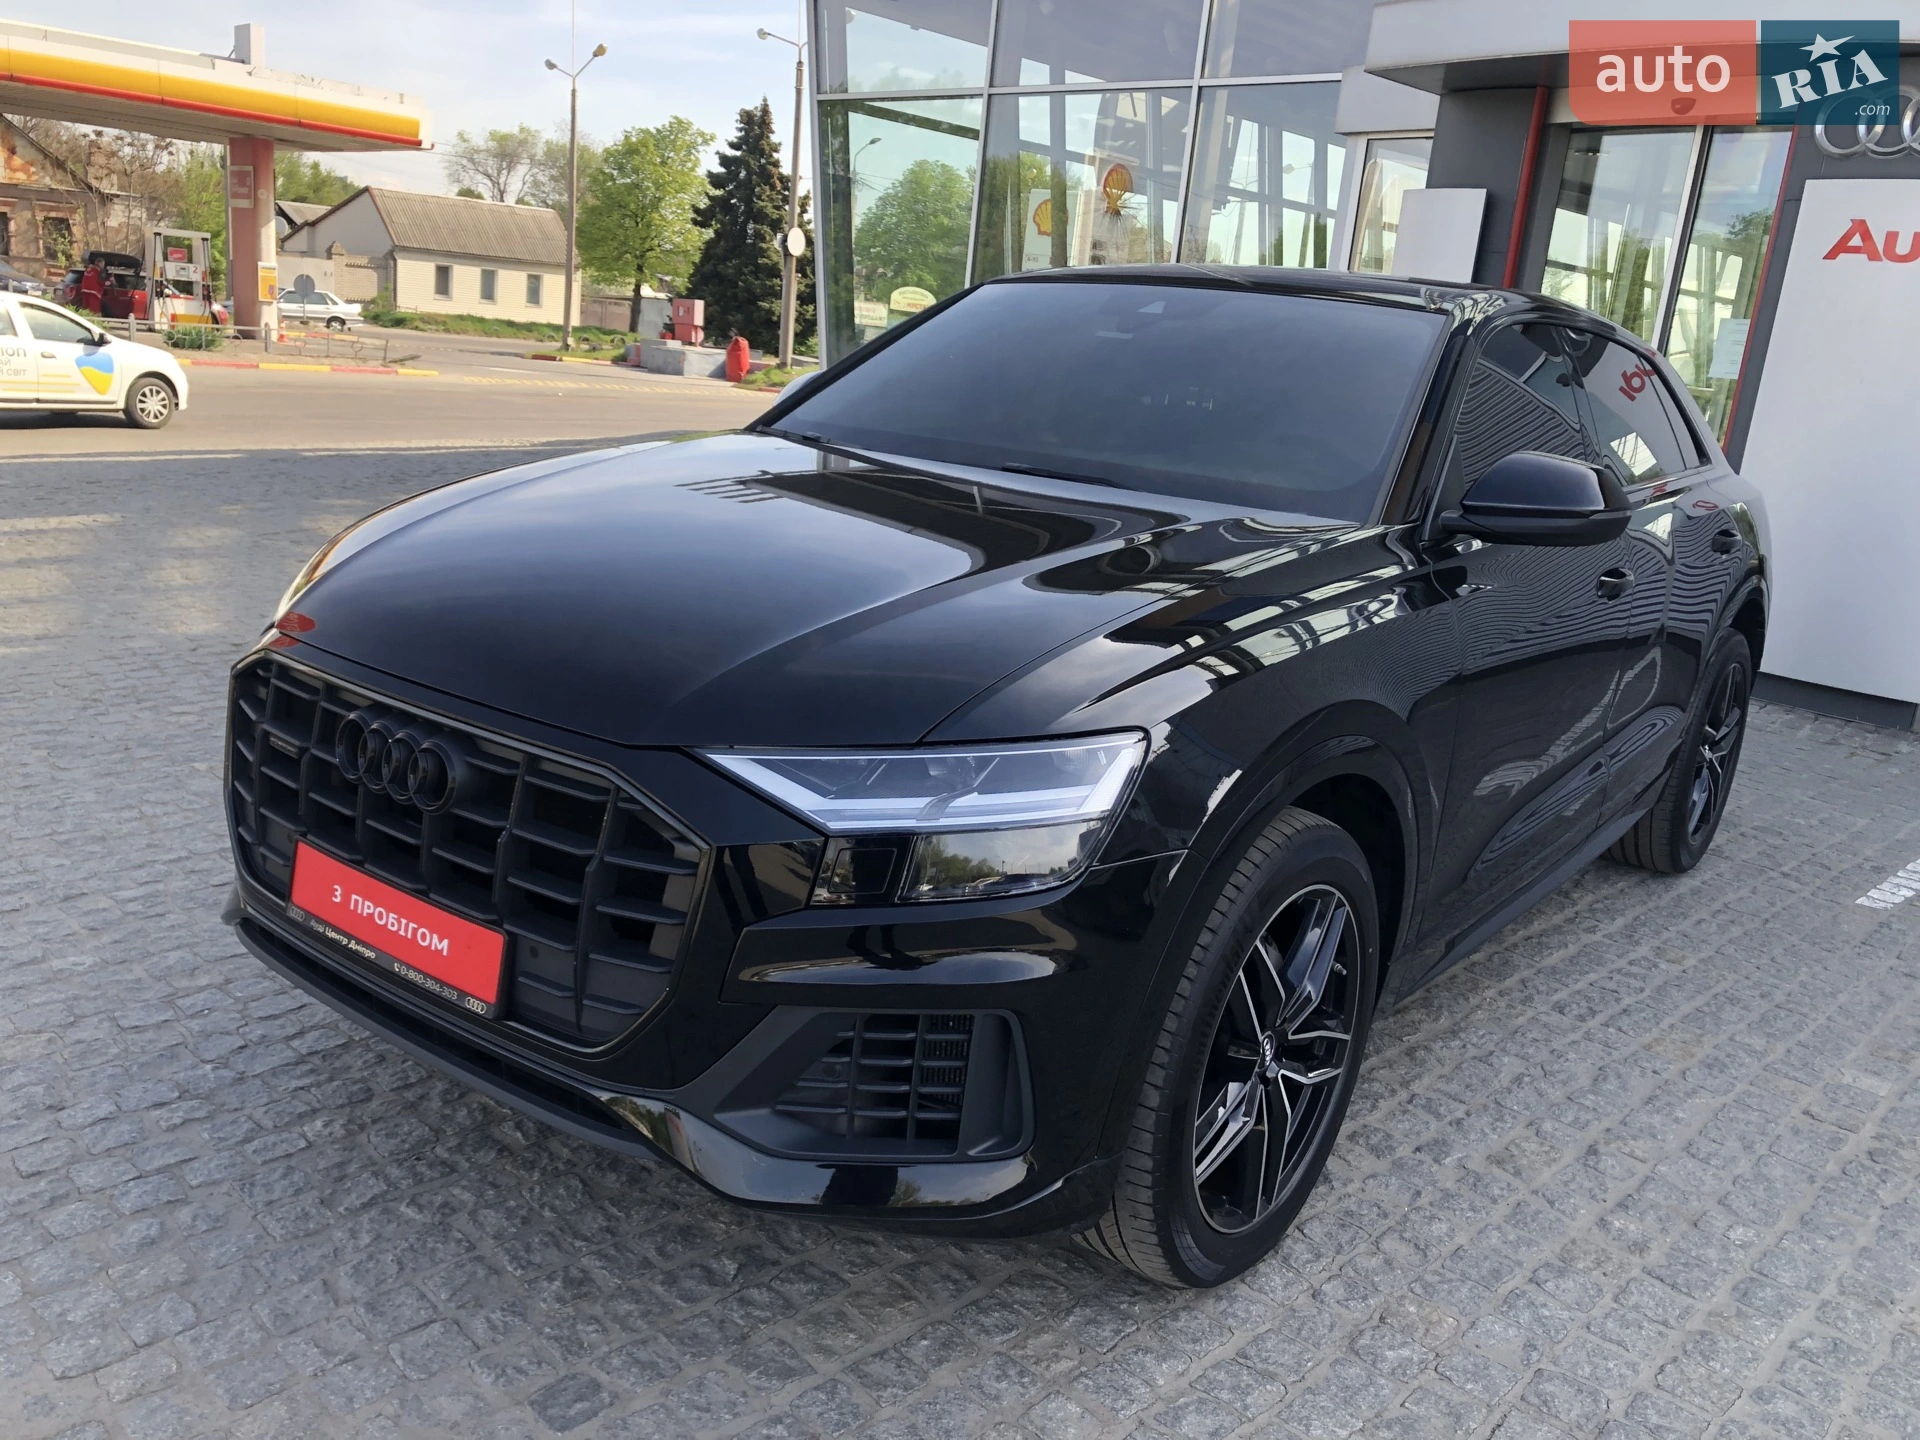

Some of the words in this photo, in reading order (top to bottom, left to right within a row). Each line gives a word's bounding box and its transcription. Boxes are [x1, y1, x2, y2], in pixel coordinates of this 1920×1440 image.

[192, 265, 199, 274] 2
[331, 884, 342, 903] З
[350, 894, 449, 956] ПРОБІГОМ
[325, 926, 348, 945] Центр
[348, 940, 376, 959] Дніпро
[400, 966, 458, 1000] 0-800-304-303
